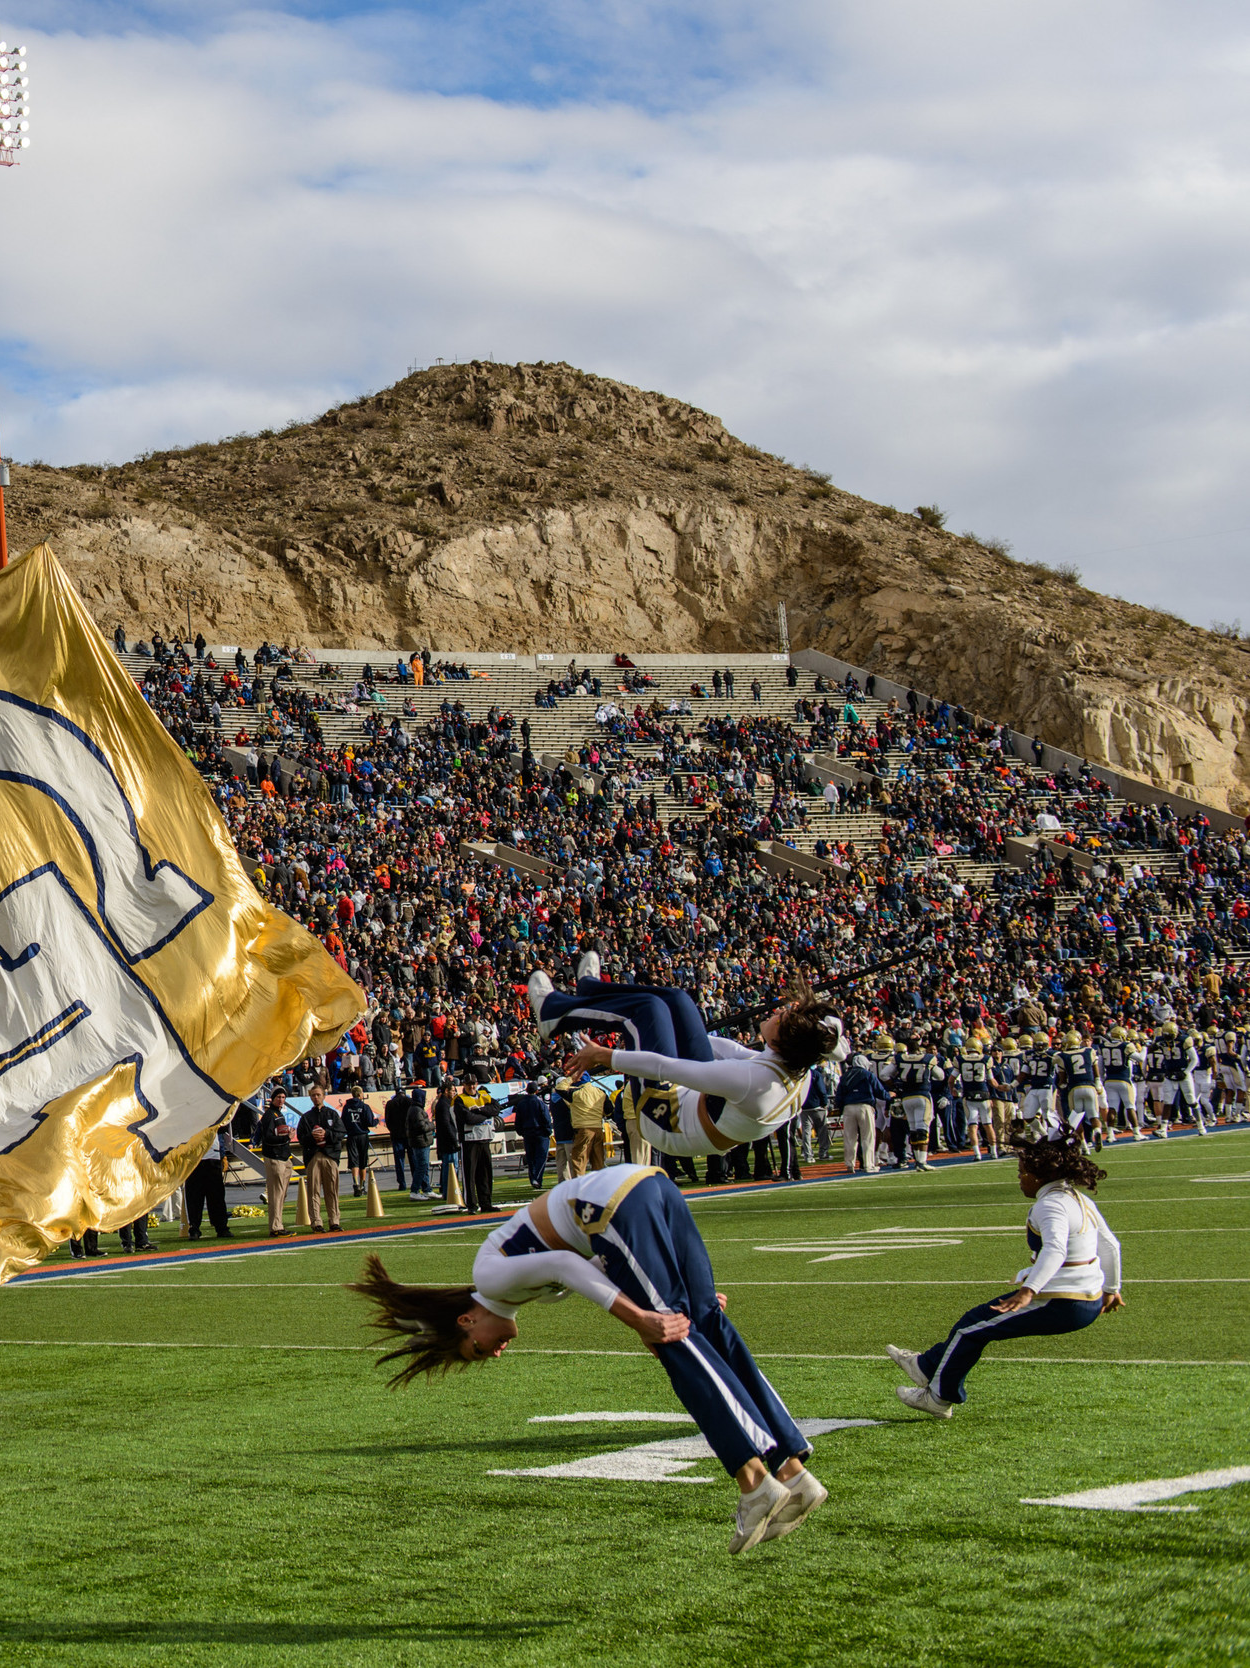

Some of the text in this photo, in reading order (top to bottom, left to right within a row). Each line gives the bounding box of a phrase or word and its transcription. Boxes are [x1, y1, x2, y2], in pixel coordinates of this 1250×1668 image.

[1071, 1055, 1087, 1075] 2
[1102, 1048, 1123, 1066] 99
[899, 1063, 926, 1083] 77
[961, 1062, 986, 1083] 63
